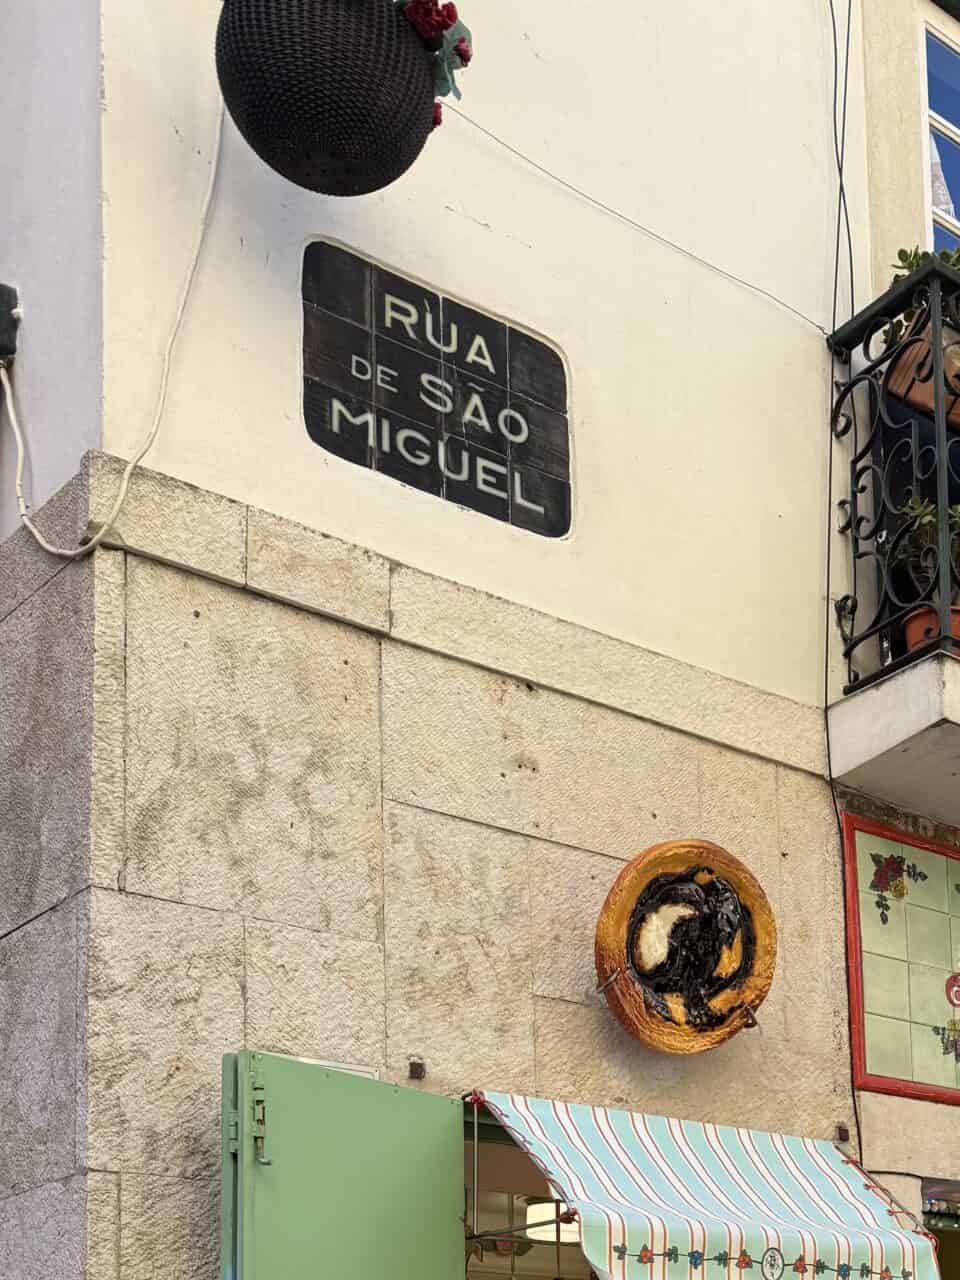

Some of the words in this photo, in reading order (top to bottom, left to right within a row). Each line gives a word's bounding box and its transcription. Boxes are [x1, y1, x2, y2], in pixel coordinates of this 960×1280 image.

[351, 354, 398, 393] DE
[419, 372, 529, 444] SÃO
[331, 397, 545, 515] MIGUEL
